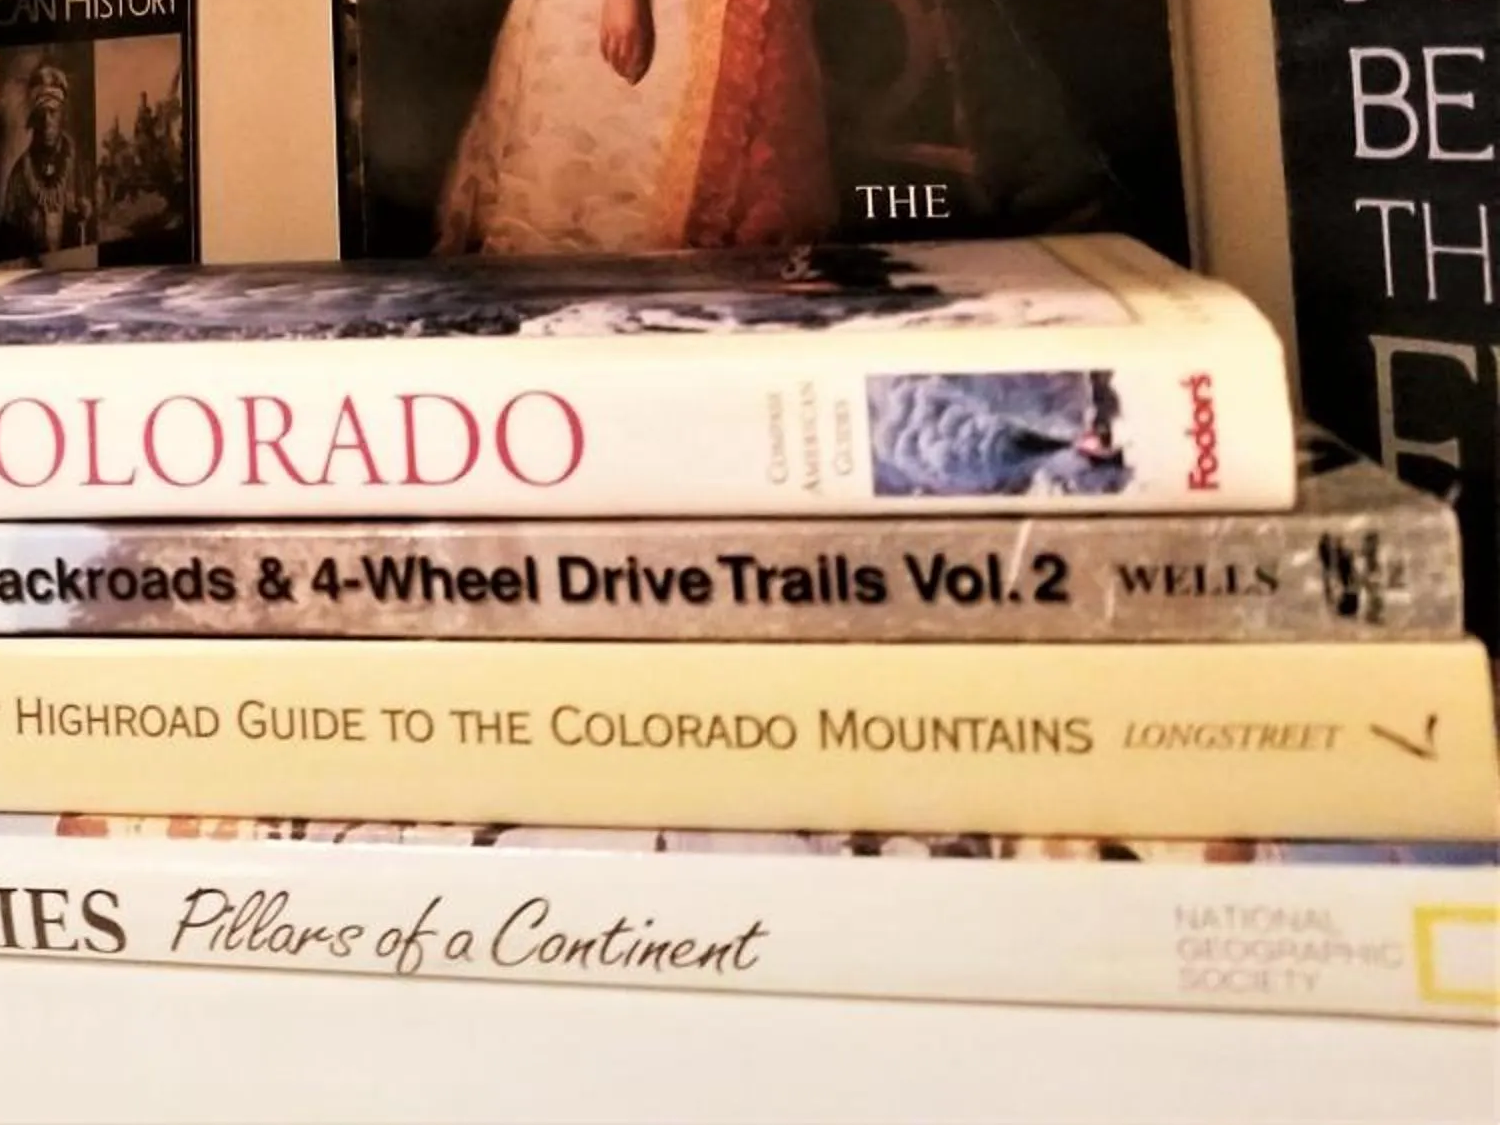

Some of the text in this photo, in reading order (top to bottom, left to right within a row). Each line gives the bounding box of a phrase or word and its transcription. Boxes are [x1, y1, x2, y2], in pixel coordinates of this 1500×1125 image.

[1349, 46, 1495, 161] BE
[855, 183, 951, 219] THE
[1180, 371, 1219, 491] Fodor's
[257, 557, 295, 604] &
[311, 555, 540, 605] 4-Wheel
[557, 555, 714, 605] Drive
[715, 554, 889, 605] Trails
[1117, 564, 1280, 597] WELLS
[15, 697, 220, 739] HIGHROAD
[237, 699, 366, 741] GUIDE
[381, 707, 435, 743] TO
[449, 709, 532, 745] THE
[550, 704, 798, 751] COLORADO
[818, 708, 1095, 756] MOUNTAINS
[1121, 721, 1343, 753] LONGSTREET
[171, 886, 366, 959] Pillars
[374, 896, 441, 975] of
[443, 931, 476, 963] a
[491, 896, 772, 974] Continent
[1174, 904, 1342, 937] NATIONAL
[1175, 937, 1405, 971] GEOGRAPHIC
[1177, 968, 1321, 996] SOCIETY
